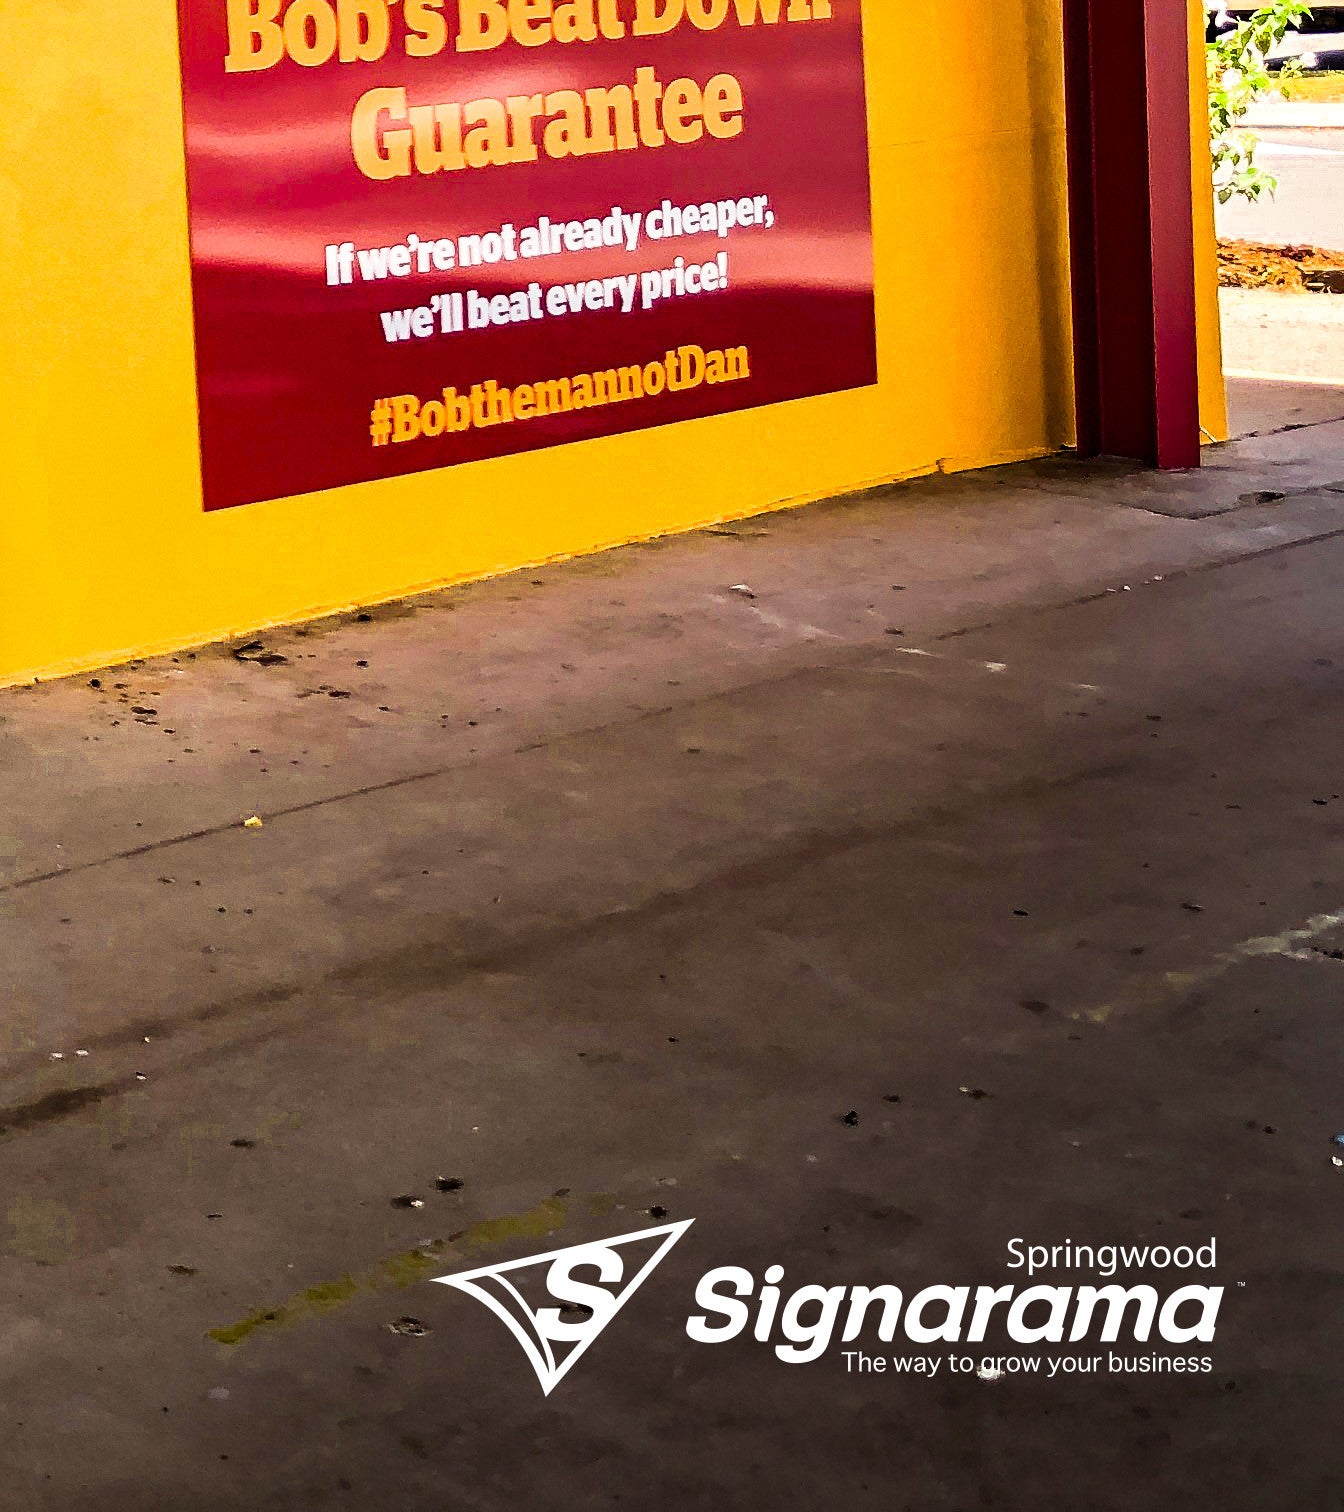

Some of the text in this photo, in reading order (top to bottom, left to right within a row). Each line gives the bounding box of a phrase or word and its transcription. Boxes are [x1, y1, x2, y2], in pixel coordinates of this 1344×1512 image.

[350, 66, 745, 181] Guarantee
[324, 194, 775, 288] If we're not already cheaper,
[380, 252, 730, 345] we'll beat every price!
[368, 344, 750, 448] #BobthemannotDan
